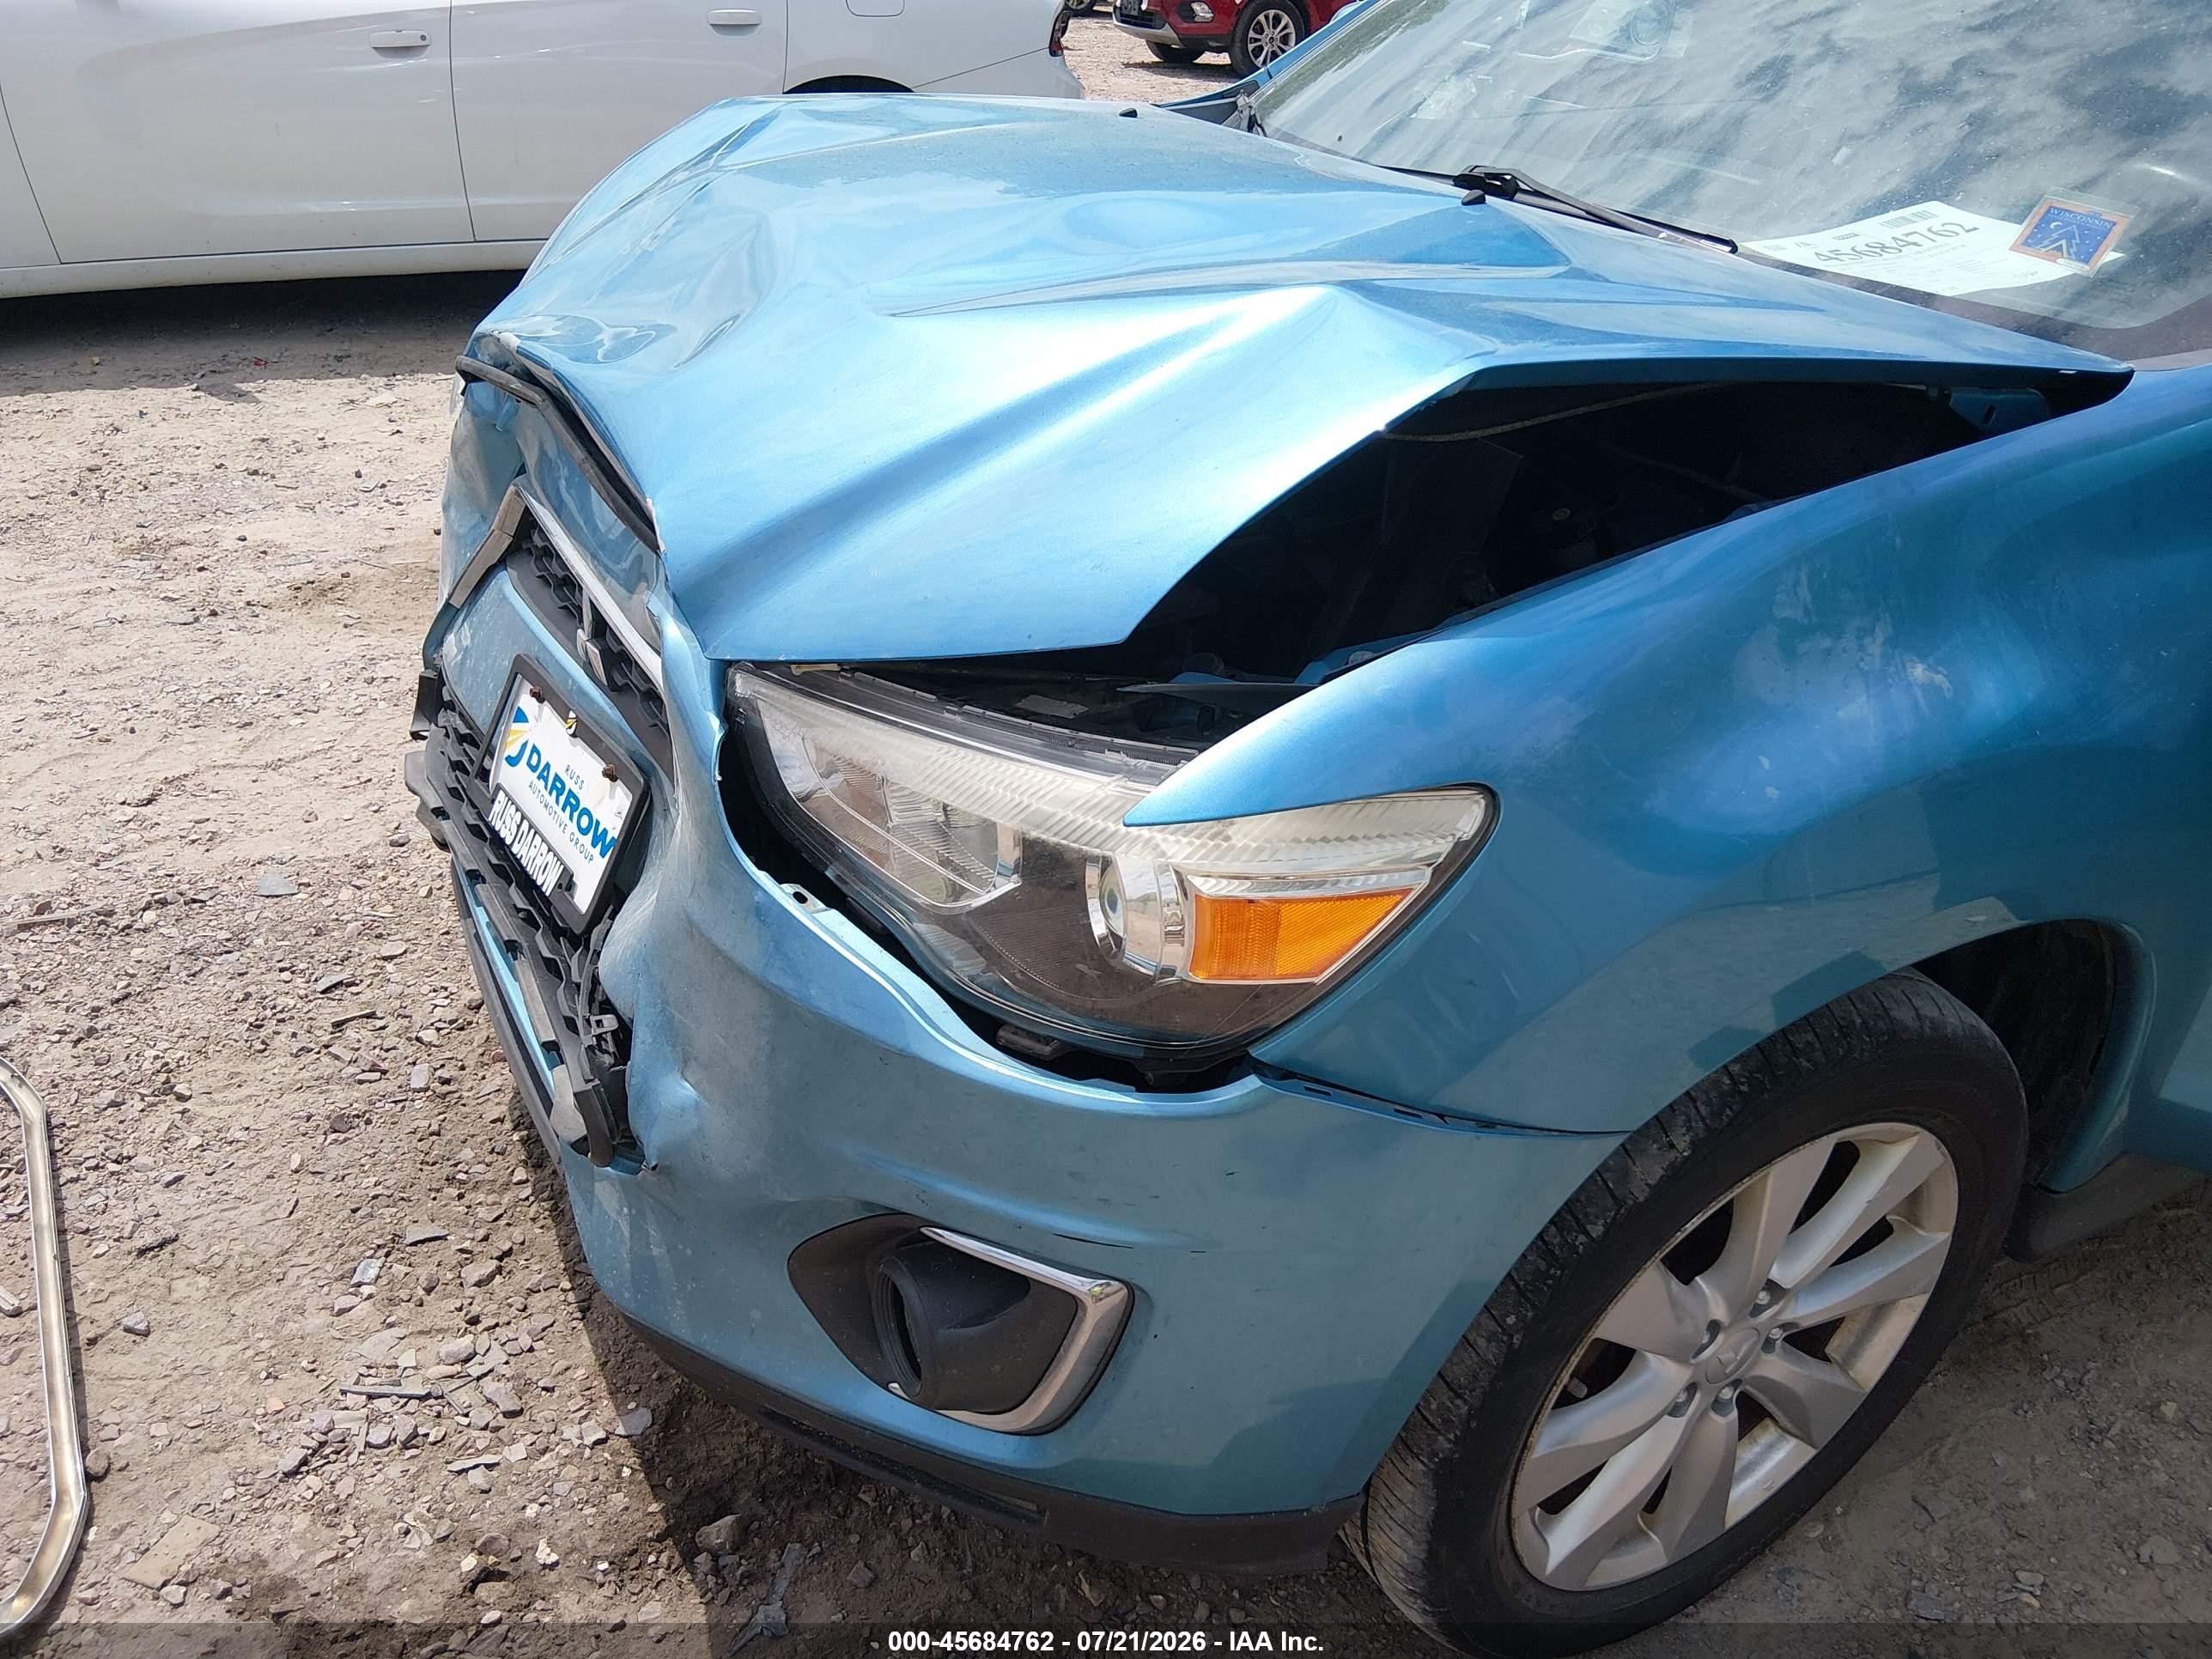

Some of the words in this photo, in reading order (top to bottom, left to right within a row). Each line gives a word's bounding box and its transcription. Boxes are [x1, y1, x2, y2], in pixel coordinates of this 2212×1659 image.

[1814, 222, 1980, 263] 45684762
[2050, 207, 2113, 229] WISCONSIN
[526, 743, 617, 859] DARROW
[564, 763, 585, 791] RUSS
[488, 789, 520, 846] RUSS
[512, 820, 564, 897] DARROW
[528, 779, 567, 835] AUTOMOTIVE
[569, 831, 594, 864] GROUP
